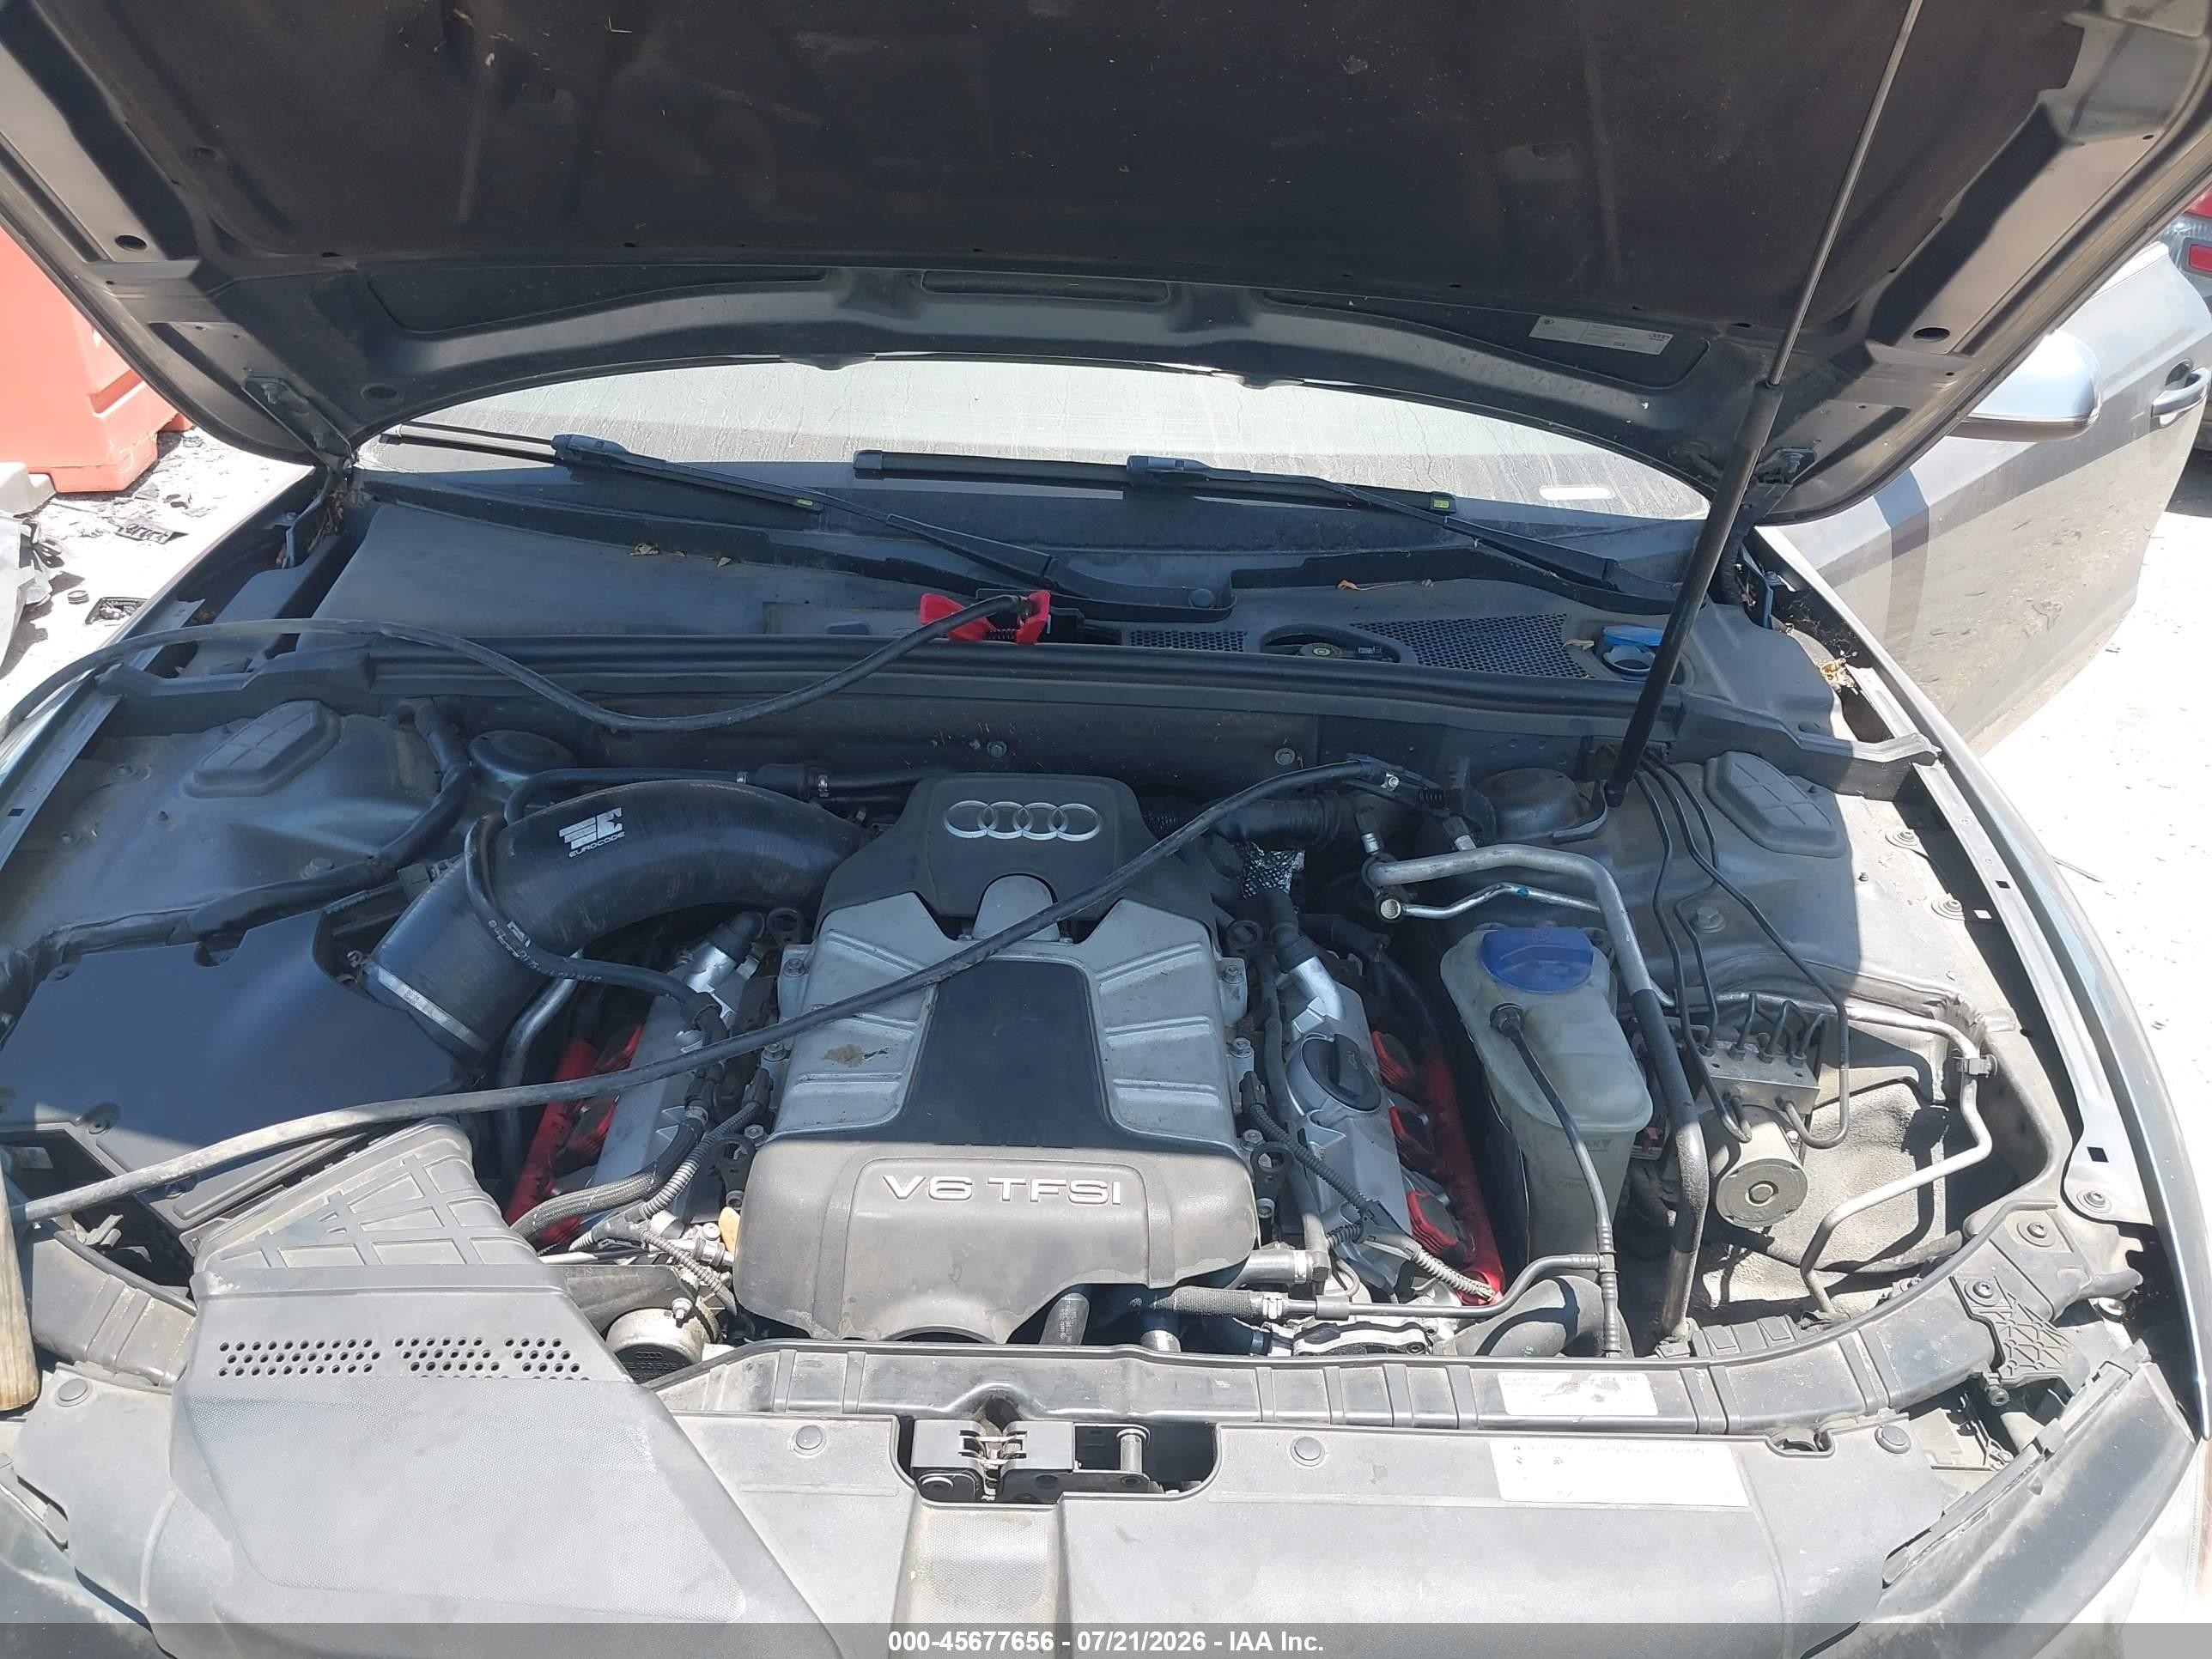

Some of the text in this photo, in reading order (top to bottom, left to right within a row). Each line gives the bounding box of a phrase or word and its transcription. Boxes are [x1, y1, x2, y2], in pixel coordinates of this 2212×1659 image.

[568, 831, 626, 858] EUROCODE
[882, 1175, 1122, 1206] V6 TFSI
